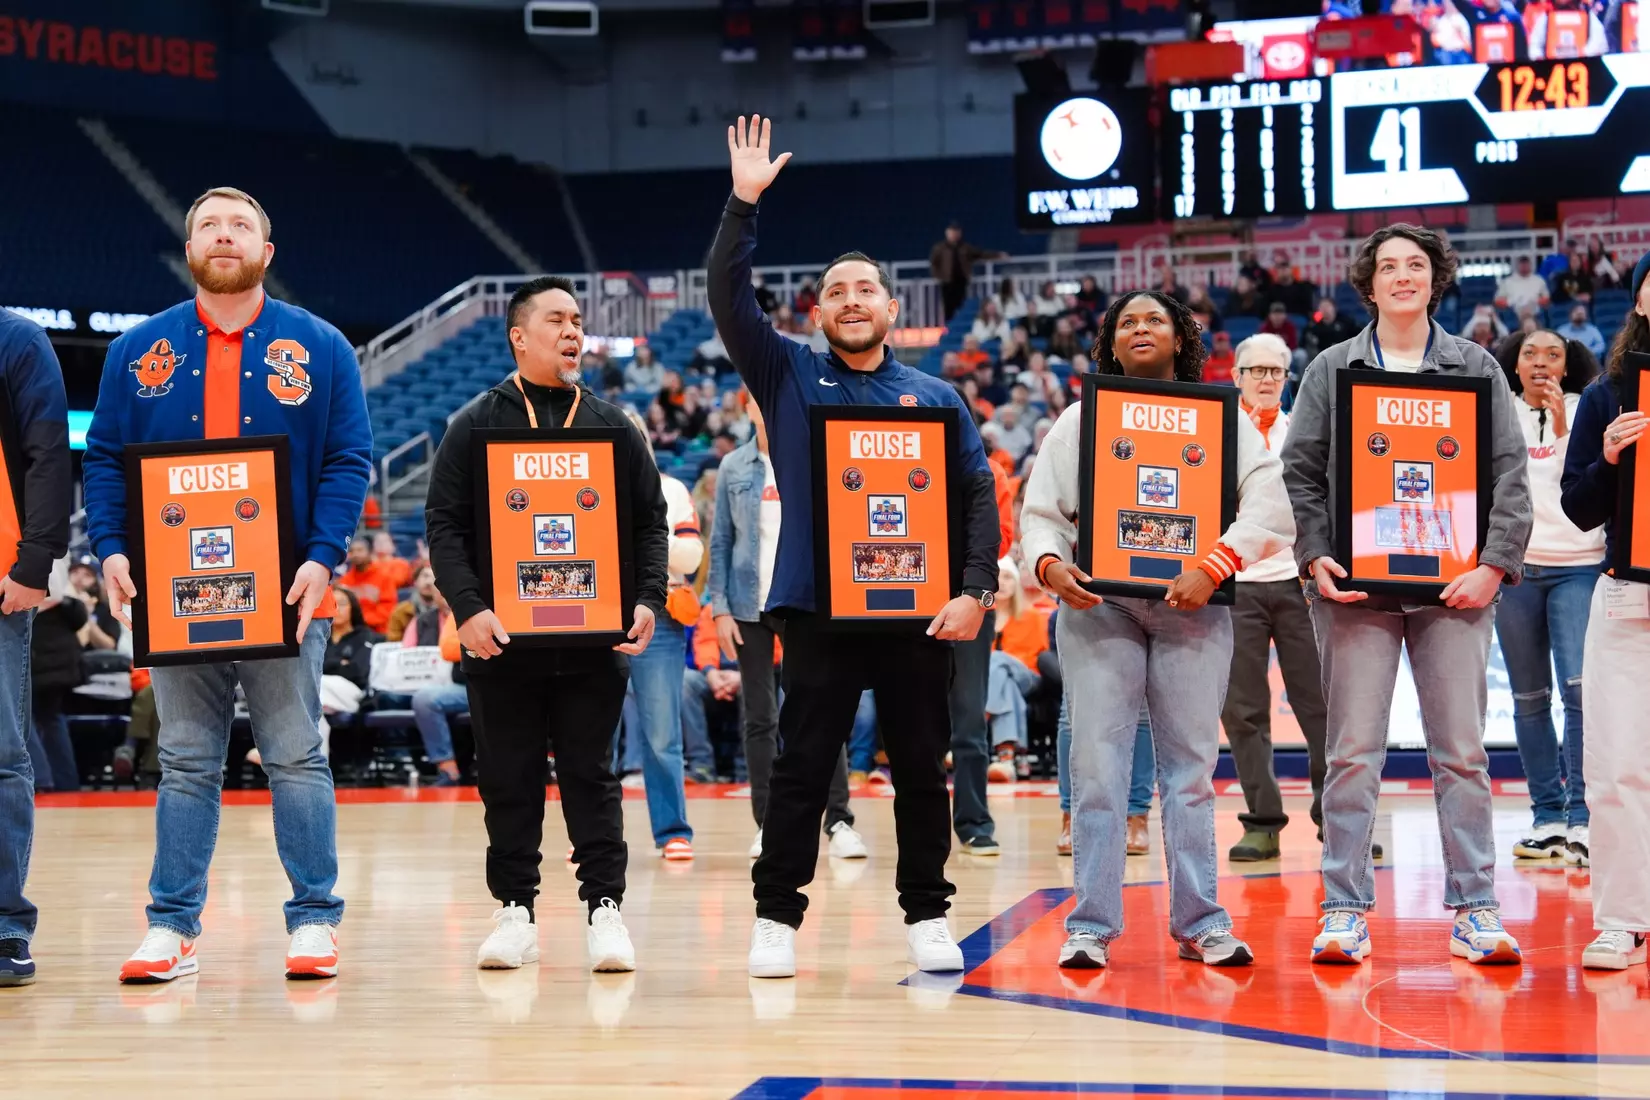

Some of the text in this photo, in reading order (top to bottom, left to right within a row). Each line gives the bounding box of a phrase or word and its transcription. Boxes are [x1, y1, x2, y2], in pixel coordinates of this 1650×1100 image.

[0, 15, 218, 80] SYRACUSE
[1497, 62, 1589, 112] 12:43
[1369, 106, 1421, 173] 41
[1125, 404, 1190, 433] 'CUSE
[1380, 398, 1443, 426] 'CUSE
[852, 432, 914, 458] 'CUSE
[171, 464, 241, 492] 'CUSE
[517, 454, 582, 478] 'CUSE
